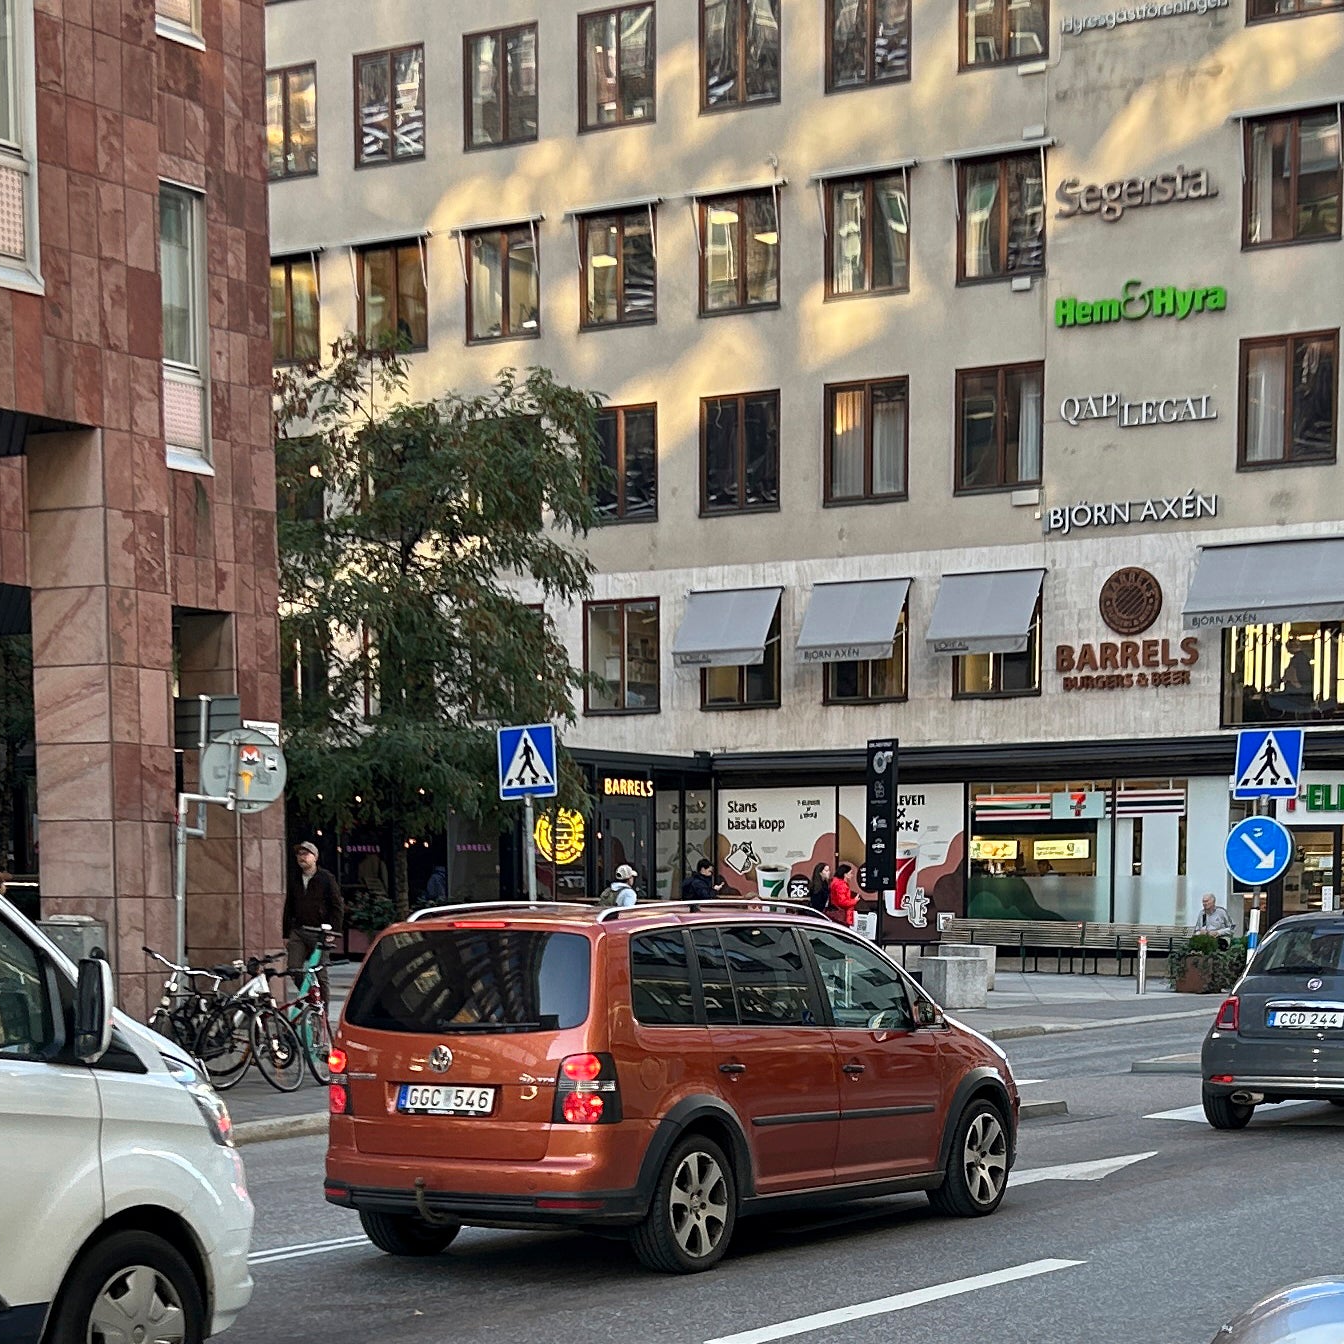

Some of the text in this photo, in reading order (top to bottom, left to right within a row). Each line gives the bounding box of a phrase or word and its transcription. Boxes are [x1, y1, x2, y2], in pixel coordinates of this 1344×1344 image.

[1060, 392, 1218, 428] QAP LEGAL
[1049, 488, 1218, 535] BJÖRN AXÉN
[1056, 636, 1201, 674] BARRELS
[1062, 672, 1134, 693] BURGERS
[1150, 669, 1192, 688] BEER
[603, 777, 654, 798] BARRELS
[727, 801, 758, 813] Stans
[727, 817, 786, 832] bästa kopp
[1279, 1011, 1338, 1025] CGD 244
[408, 1087, 489, 1109] GGC 546
